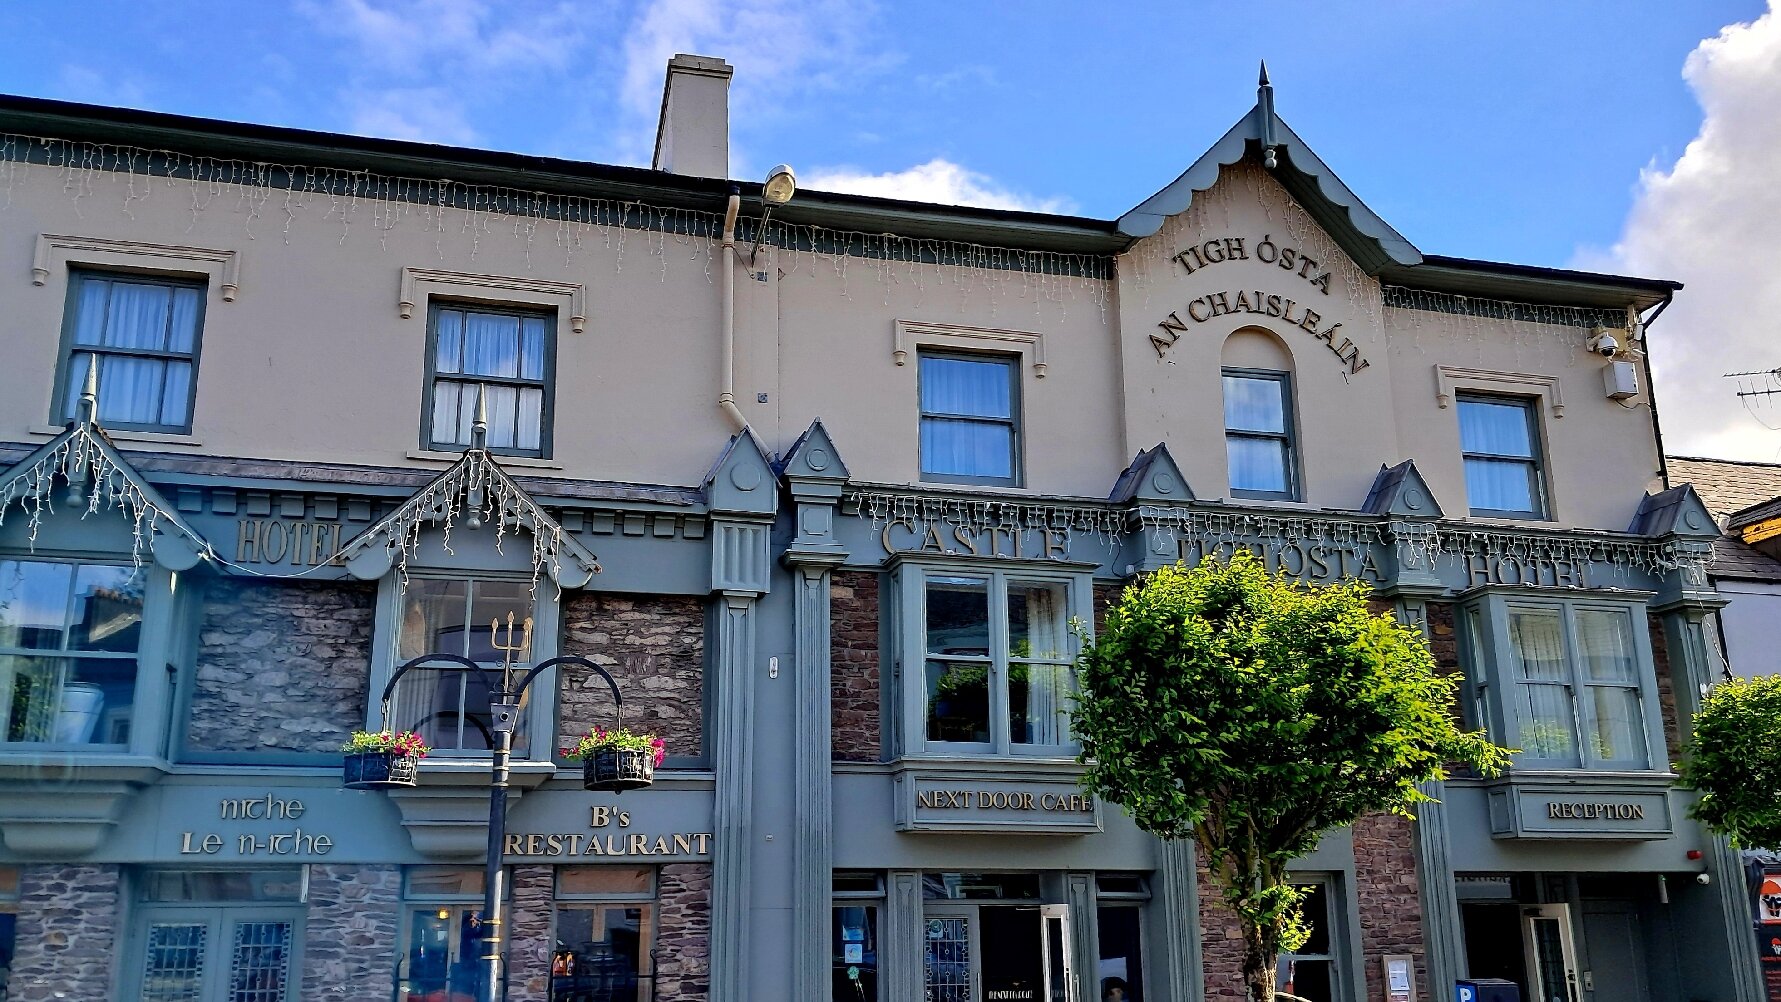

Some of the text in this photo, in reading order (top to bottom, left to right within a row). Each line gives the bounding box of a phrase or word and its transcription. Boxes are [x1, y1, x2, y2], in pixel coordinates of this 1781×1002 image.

[1172, 234, 1331, 295] TIGH ÓSTA
[1149, 290, 1370, 375] AN CHAISLEÁIN
[235, 520, 347, 567] HOTEL
[916, 790, 973, 809] NEXT
[977, 791, 1036, 810] DOOR
[1547, 802, 1645, 820] RECEPTION
[590, 805, 631, 828] B's
[180, 832, 224, 854] Le
[503, 832, 713, 856] RESTAURANT
